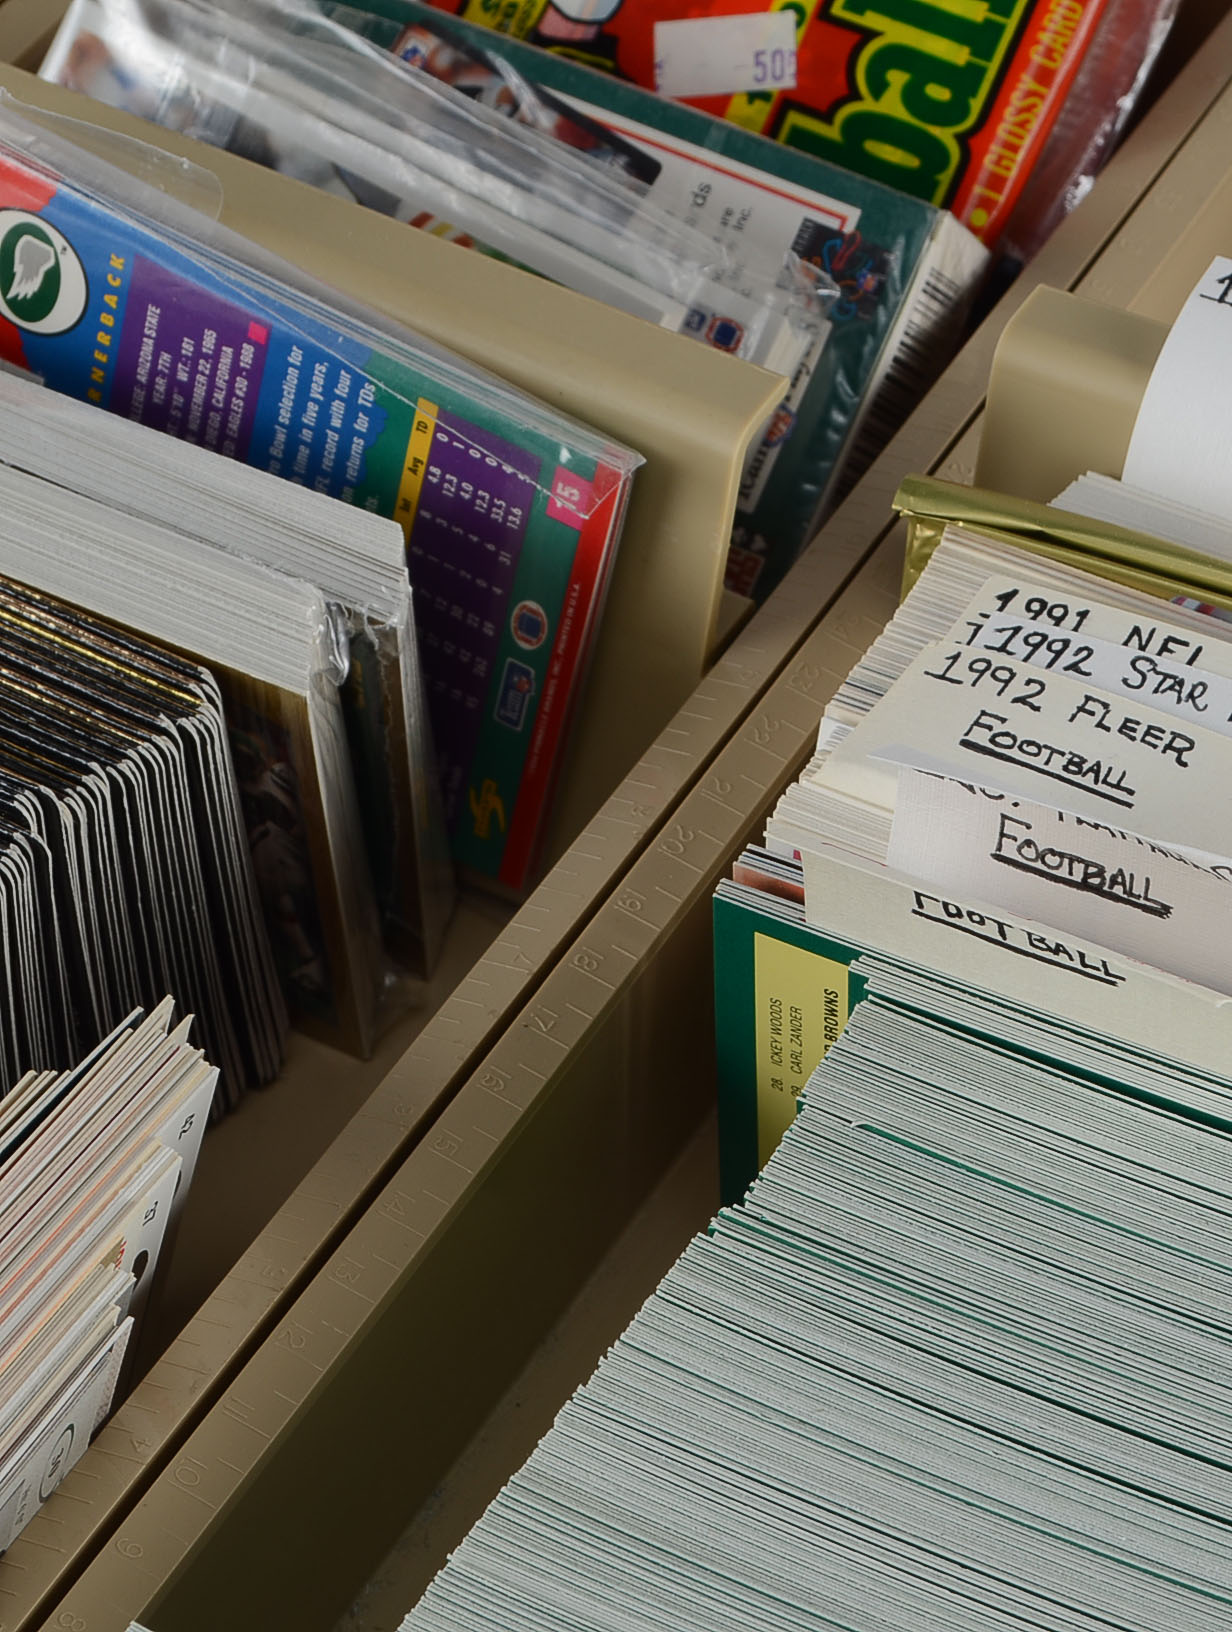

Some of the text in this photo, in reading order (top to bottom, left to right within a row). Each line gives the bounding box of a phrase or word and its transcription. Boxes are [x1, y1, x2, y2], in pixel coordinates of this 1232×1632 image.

[783, 0, 1018, 207] bal
[983, 73, 1048, 178] GLOSSY
[147, 304, 161, 338] STATE
[142, 337, 158, 385] ARIZONA
[158, 351, 172, 376] 7TH
[287, 344, 303, 366] for
[211, 345, 234, 409] CALIFORNIA
[278, 366, 300, 425] selection
[310, 361, 330, 401] years,
[334, 369, 352, 398] four
[358, 381, 376, 408] TDs
[226, 396, 245, 438] EAGLES
[302, 400, 319, 427] five
[329, 398, 346, 429] with
[353, 411, 370, 433] for
[269, 424, 288, 460] Bowl
[299, 427, 314, 444] in
[322, 428, 340, 472] record
[408, 456, 424, 477] Avg
[416, 420, 429, 434] TD
[346, 436, 365, 483] returns
[426, 465, 442, 485] 4.8
[436, 431, 449, 443] 0
[459, 480, 474, 500] 4.0
[468, 448, 481, 459] 0
[442, 473, 458, 498] 12.3
[474, 489, 490, 514] 12.3
[490, 497, 507, 523] 33.5
[506, 506, 523, 530] 13.6
[979, 587, 1091, 633] 1991
[985, 624, 1094, 677] 1992
[1121, 655, 1208, 712] STAR
[923, 651, 1196, 768] 1992 FLEER
[961, 710, 1135, 797] FOOTBALL
[993, 812, 1172, 914] FOOTBALL
[912, 890, 1126, 981] FOOTBALL
[769, 997, 783, 1036] WOODS
[790, 1005, 802, 1045] ZANDER
[823, 988, 839, 1043] BROWNS
[770, 1033, 784, 1067] ICKEY
[790, 1042, 802, 1075] CARL
